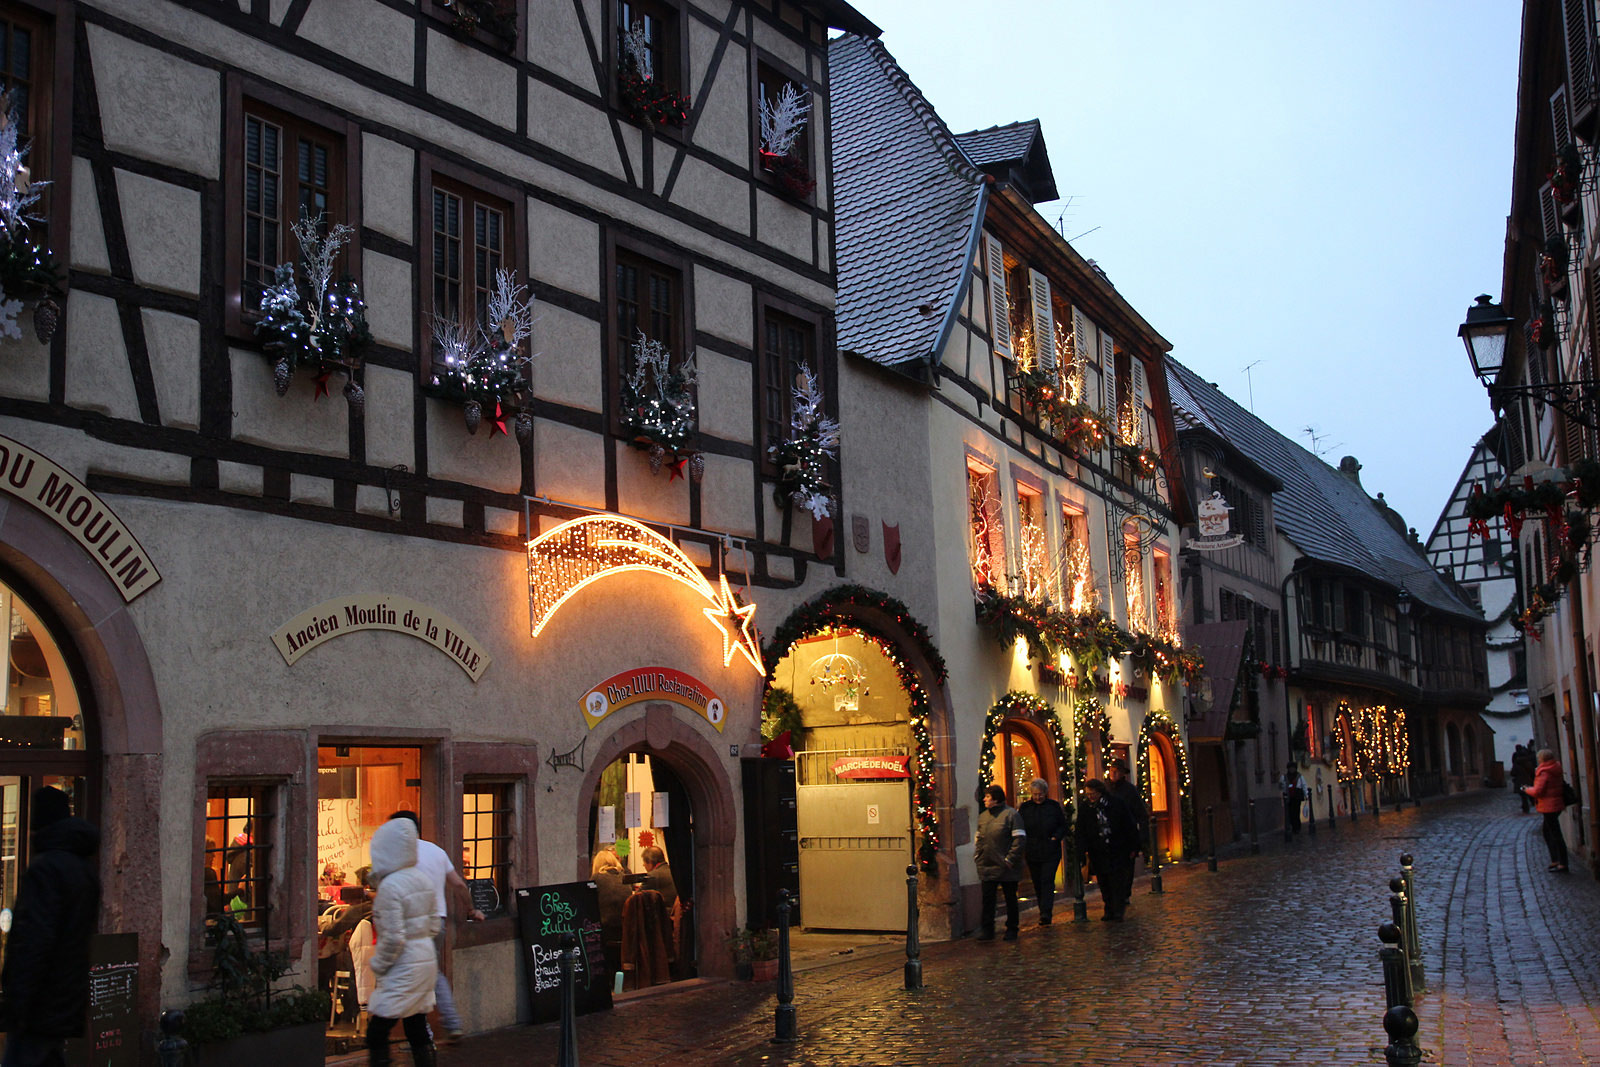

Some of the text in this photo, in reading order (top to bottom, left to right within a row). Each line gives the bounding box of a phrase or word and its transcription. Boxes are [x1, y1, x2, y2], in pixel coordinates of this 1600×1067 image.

[37, 472, 148, 590] MOULIN
[286, 604, 481, 673] Ancien Moulin de la VILLE
[608, 683, 632, 705] Chez
[658, 673, 707, 708] Restauration
[834, 758, 905, 775] MARCHÉ DE NOËL
[540, 892, 578, 920] Chez
[541, 914, 575, 936] Lulu
